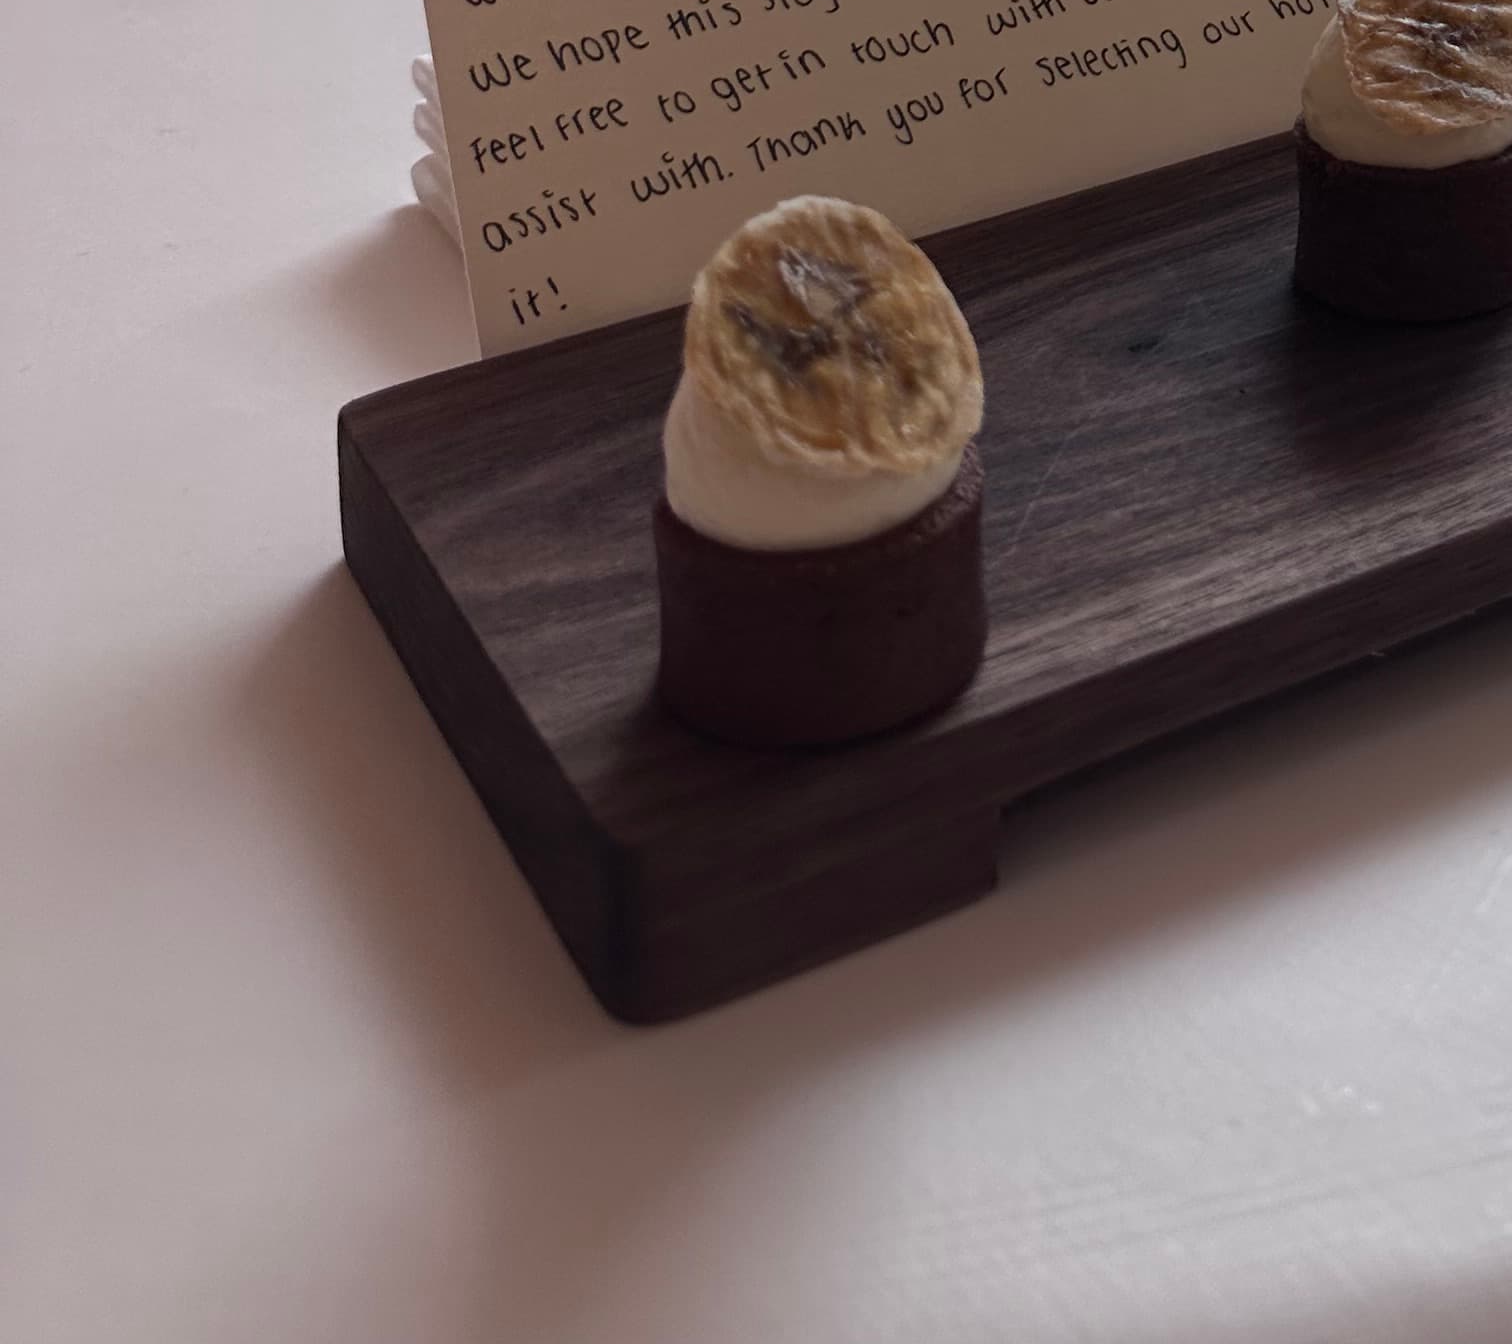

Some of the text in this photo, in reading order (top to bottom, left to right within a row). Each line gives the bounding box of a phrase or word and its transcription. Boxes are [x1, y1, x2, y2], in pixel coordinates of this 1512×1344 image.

[547, 22, 650, 72] hope
[657, 89, 697, 123] to
[777, 47, 827, 82] in
[850, 16, 955, 65] touch
[481, 187, 598, 255] assist
[630, 150, 735, 204] with.
[746, 109, 868, 173] Thank
[885, 90, 946, 146] you
[1202, 7, 1255, 46] our
[508, 275, 569, 326] it!
